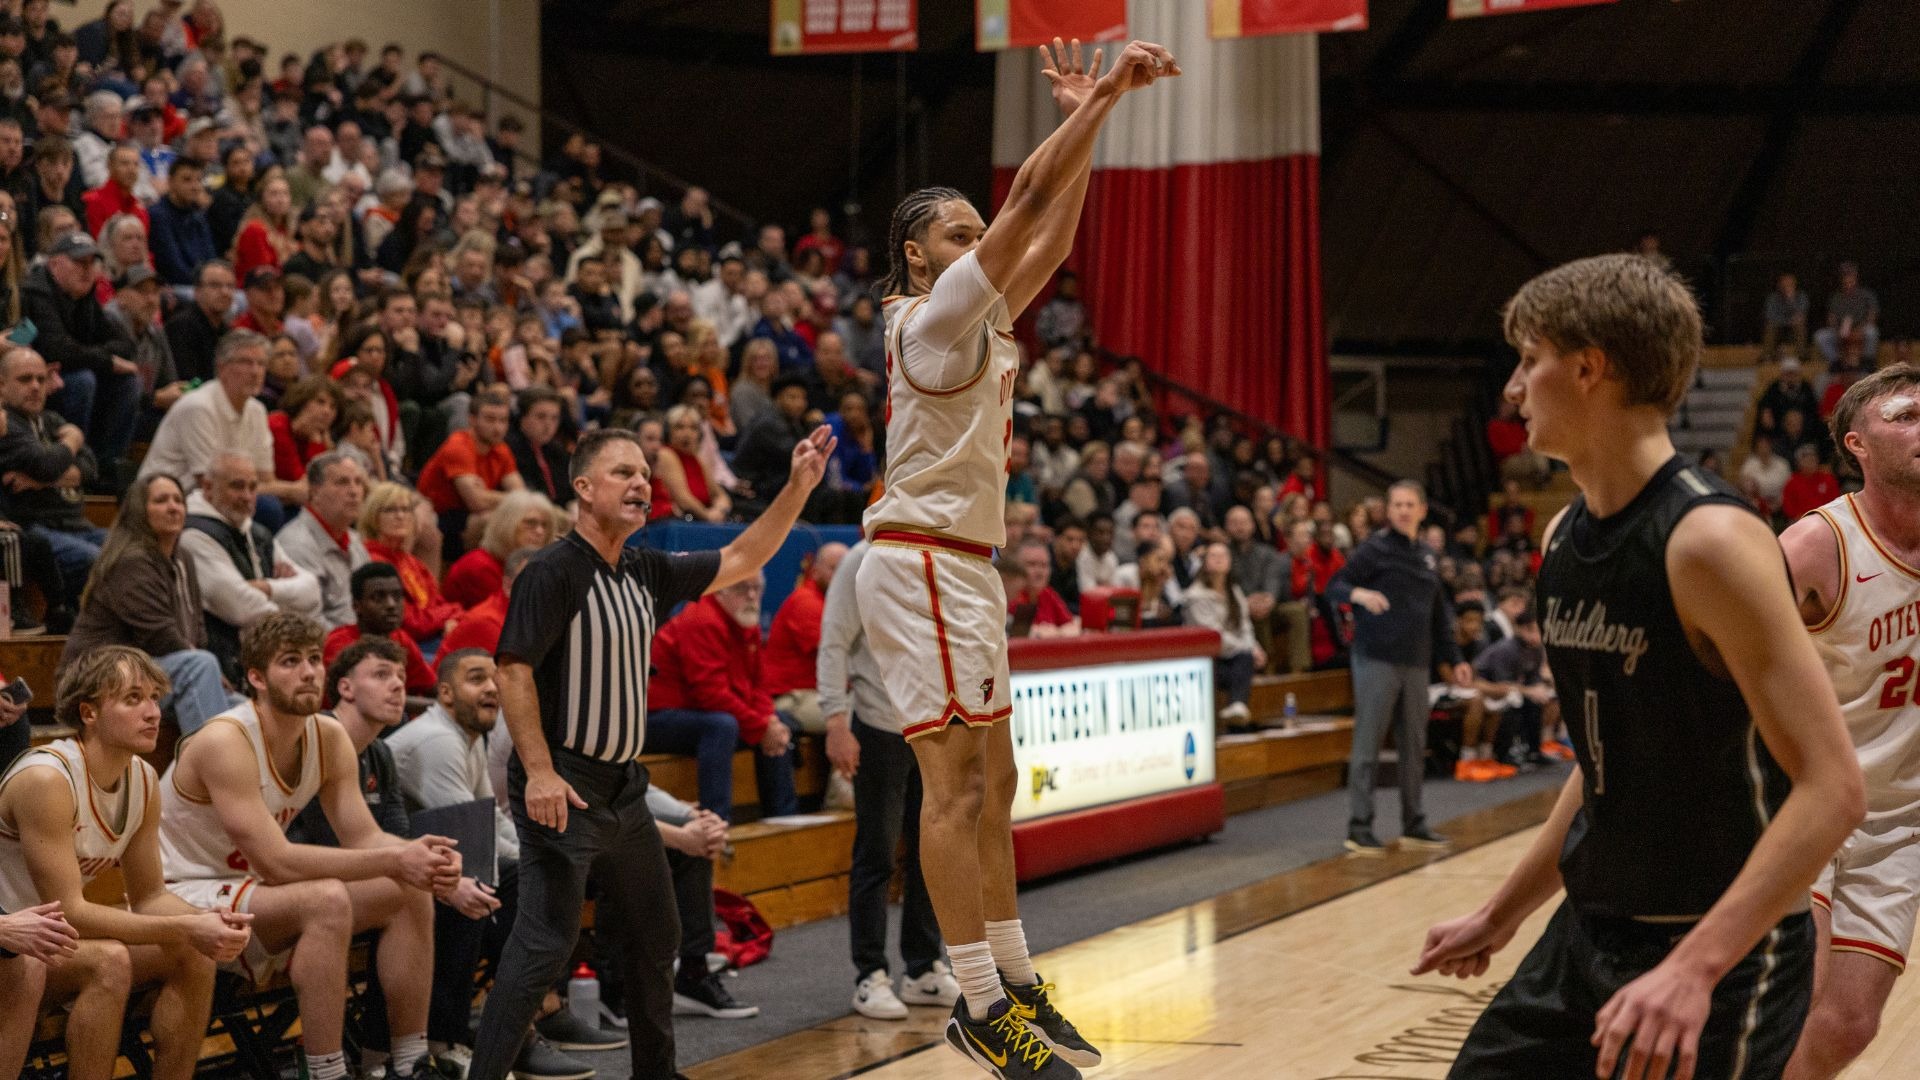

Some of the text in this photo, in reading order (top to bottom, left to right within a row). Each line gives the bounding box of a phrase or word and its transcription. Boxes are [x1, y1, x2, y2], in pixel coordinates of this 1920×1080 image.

[1543, 596, 1649, 677] Heidelberg
[1015, 669, 1206, 747] OTTERBEIN UNIVERSITY
